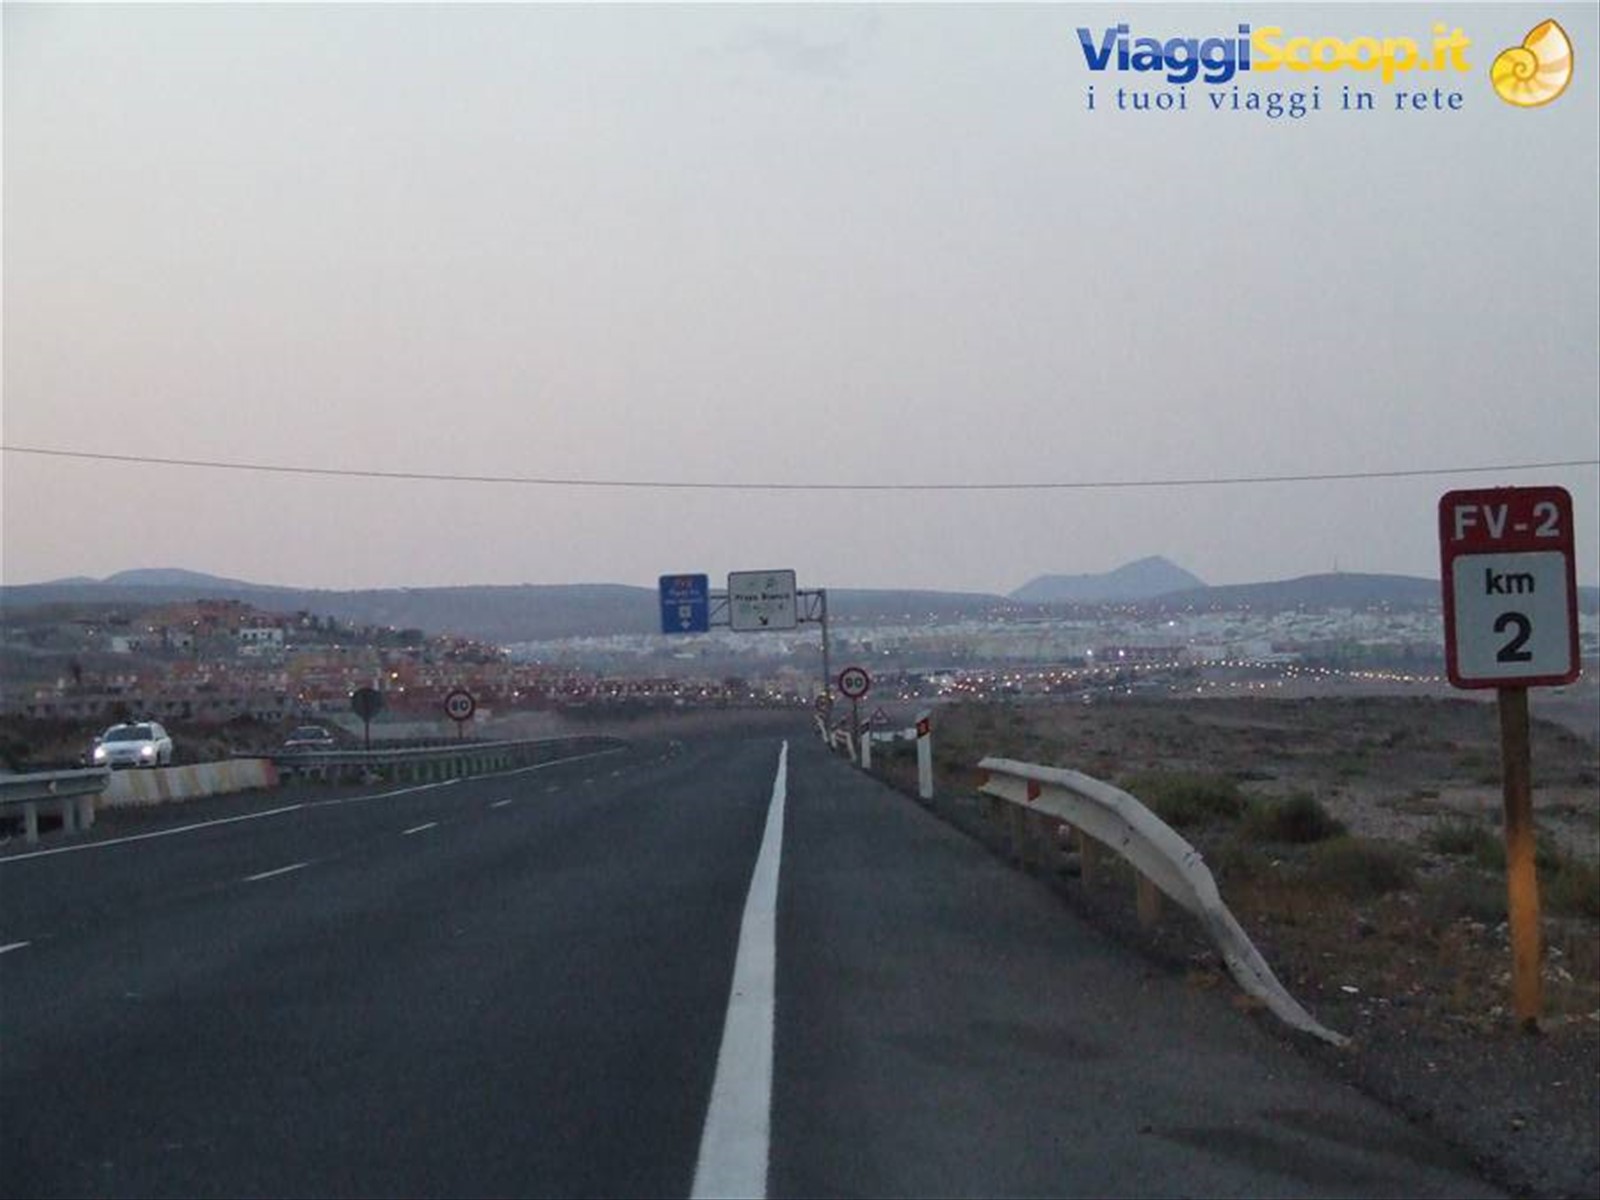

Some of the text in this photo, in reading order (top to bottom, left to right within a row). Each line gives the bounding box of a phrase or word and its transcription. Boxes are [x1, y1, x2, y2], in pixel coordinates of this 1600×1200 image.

[1453, 502, 1560, 540] FV-2
[1485, 568, 1535, 595] km
[1493, 612, 1533, 663] 2
